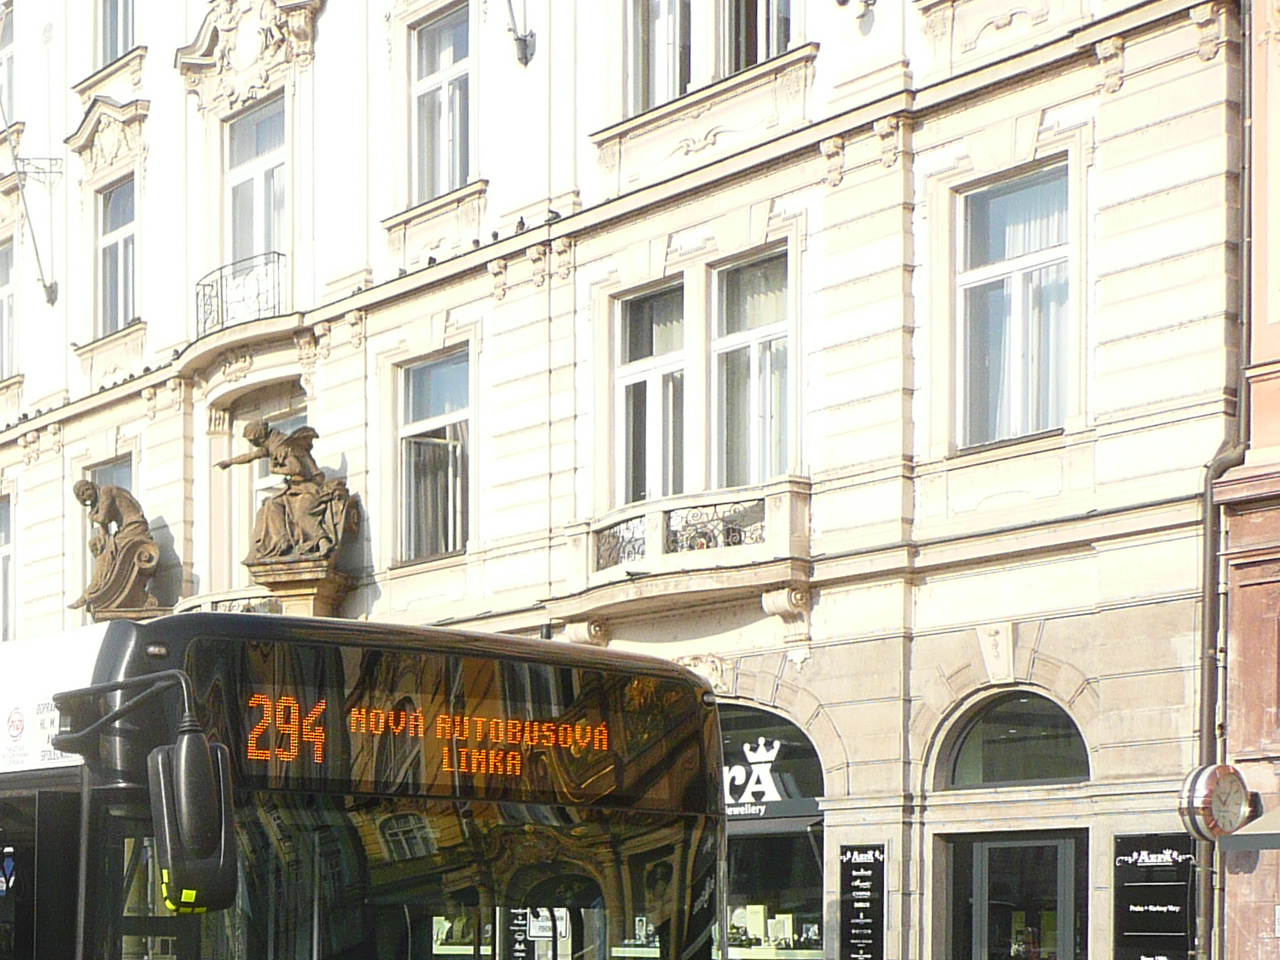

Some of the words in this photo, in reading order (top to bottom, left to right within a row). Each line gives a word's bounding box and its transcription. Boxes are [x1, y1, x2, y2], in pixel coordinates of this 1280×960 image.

[247, 694, 327, 763] 294
[350, 707, 425, 737] NOVÁ
[436, 714, 609, 750] AUTOBUSOVÁ
[442, 746, 522, 776] LINKA
